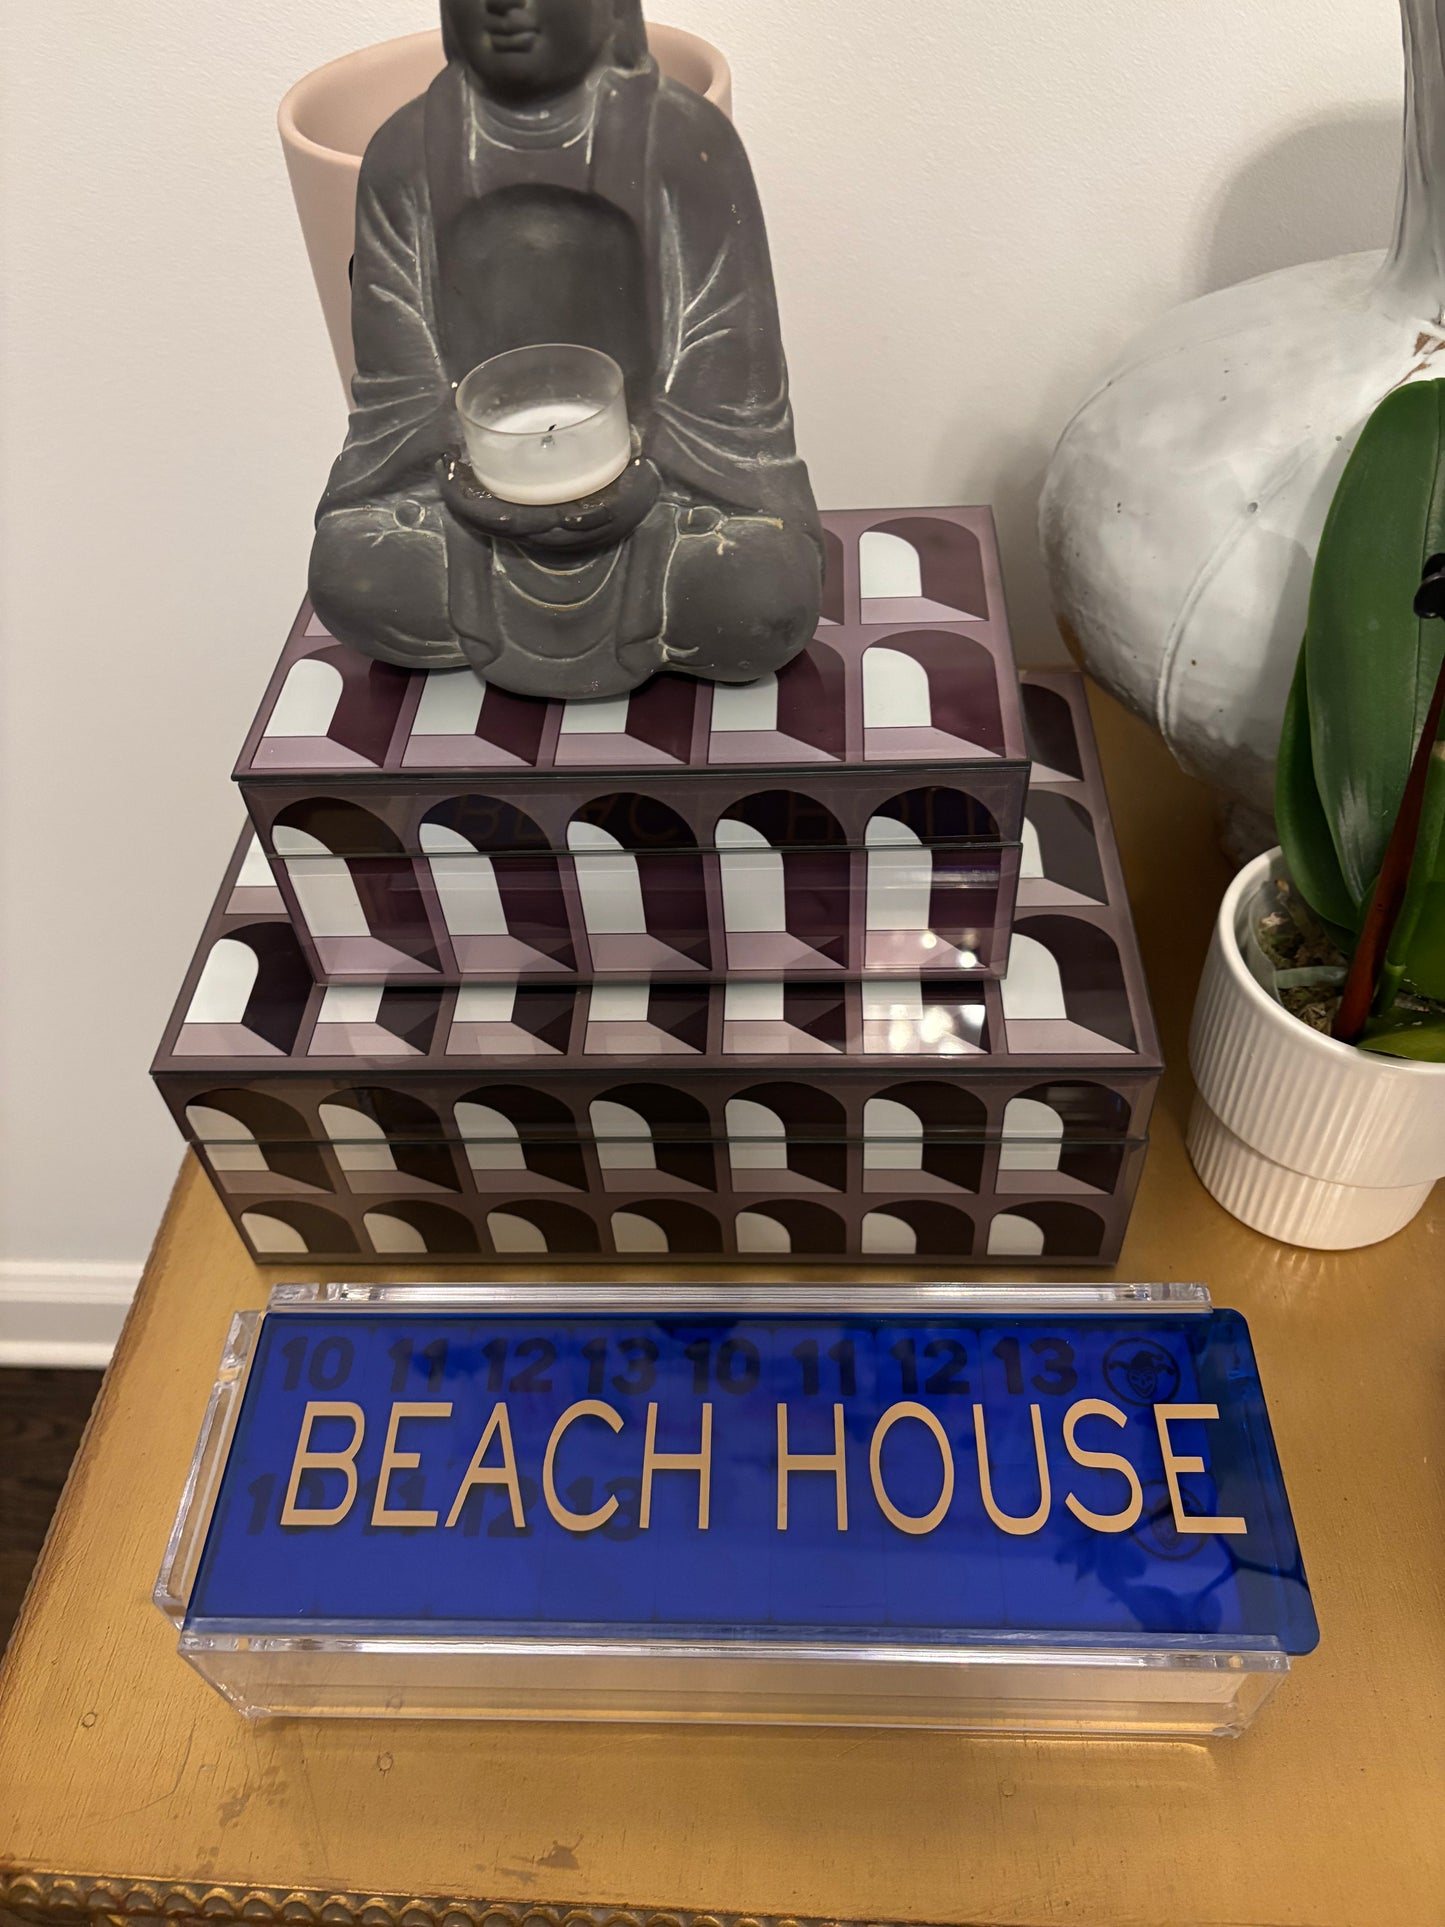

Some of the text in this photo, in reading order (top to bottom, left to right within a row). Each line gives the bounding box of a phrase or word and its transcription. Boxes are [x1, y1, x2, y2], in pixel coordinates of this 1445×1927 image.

[282, 1337, 1078, 1396] 10 11 12 13 10 11 12 13
[280, 1398, 1248, 1535] BEACH HOUSE
